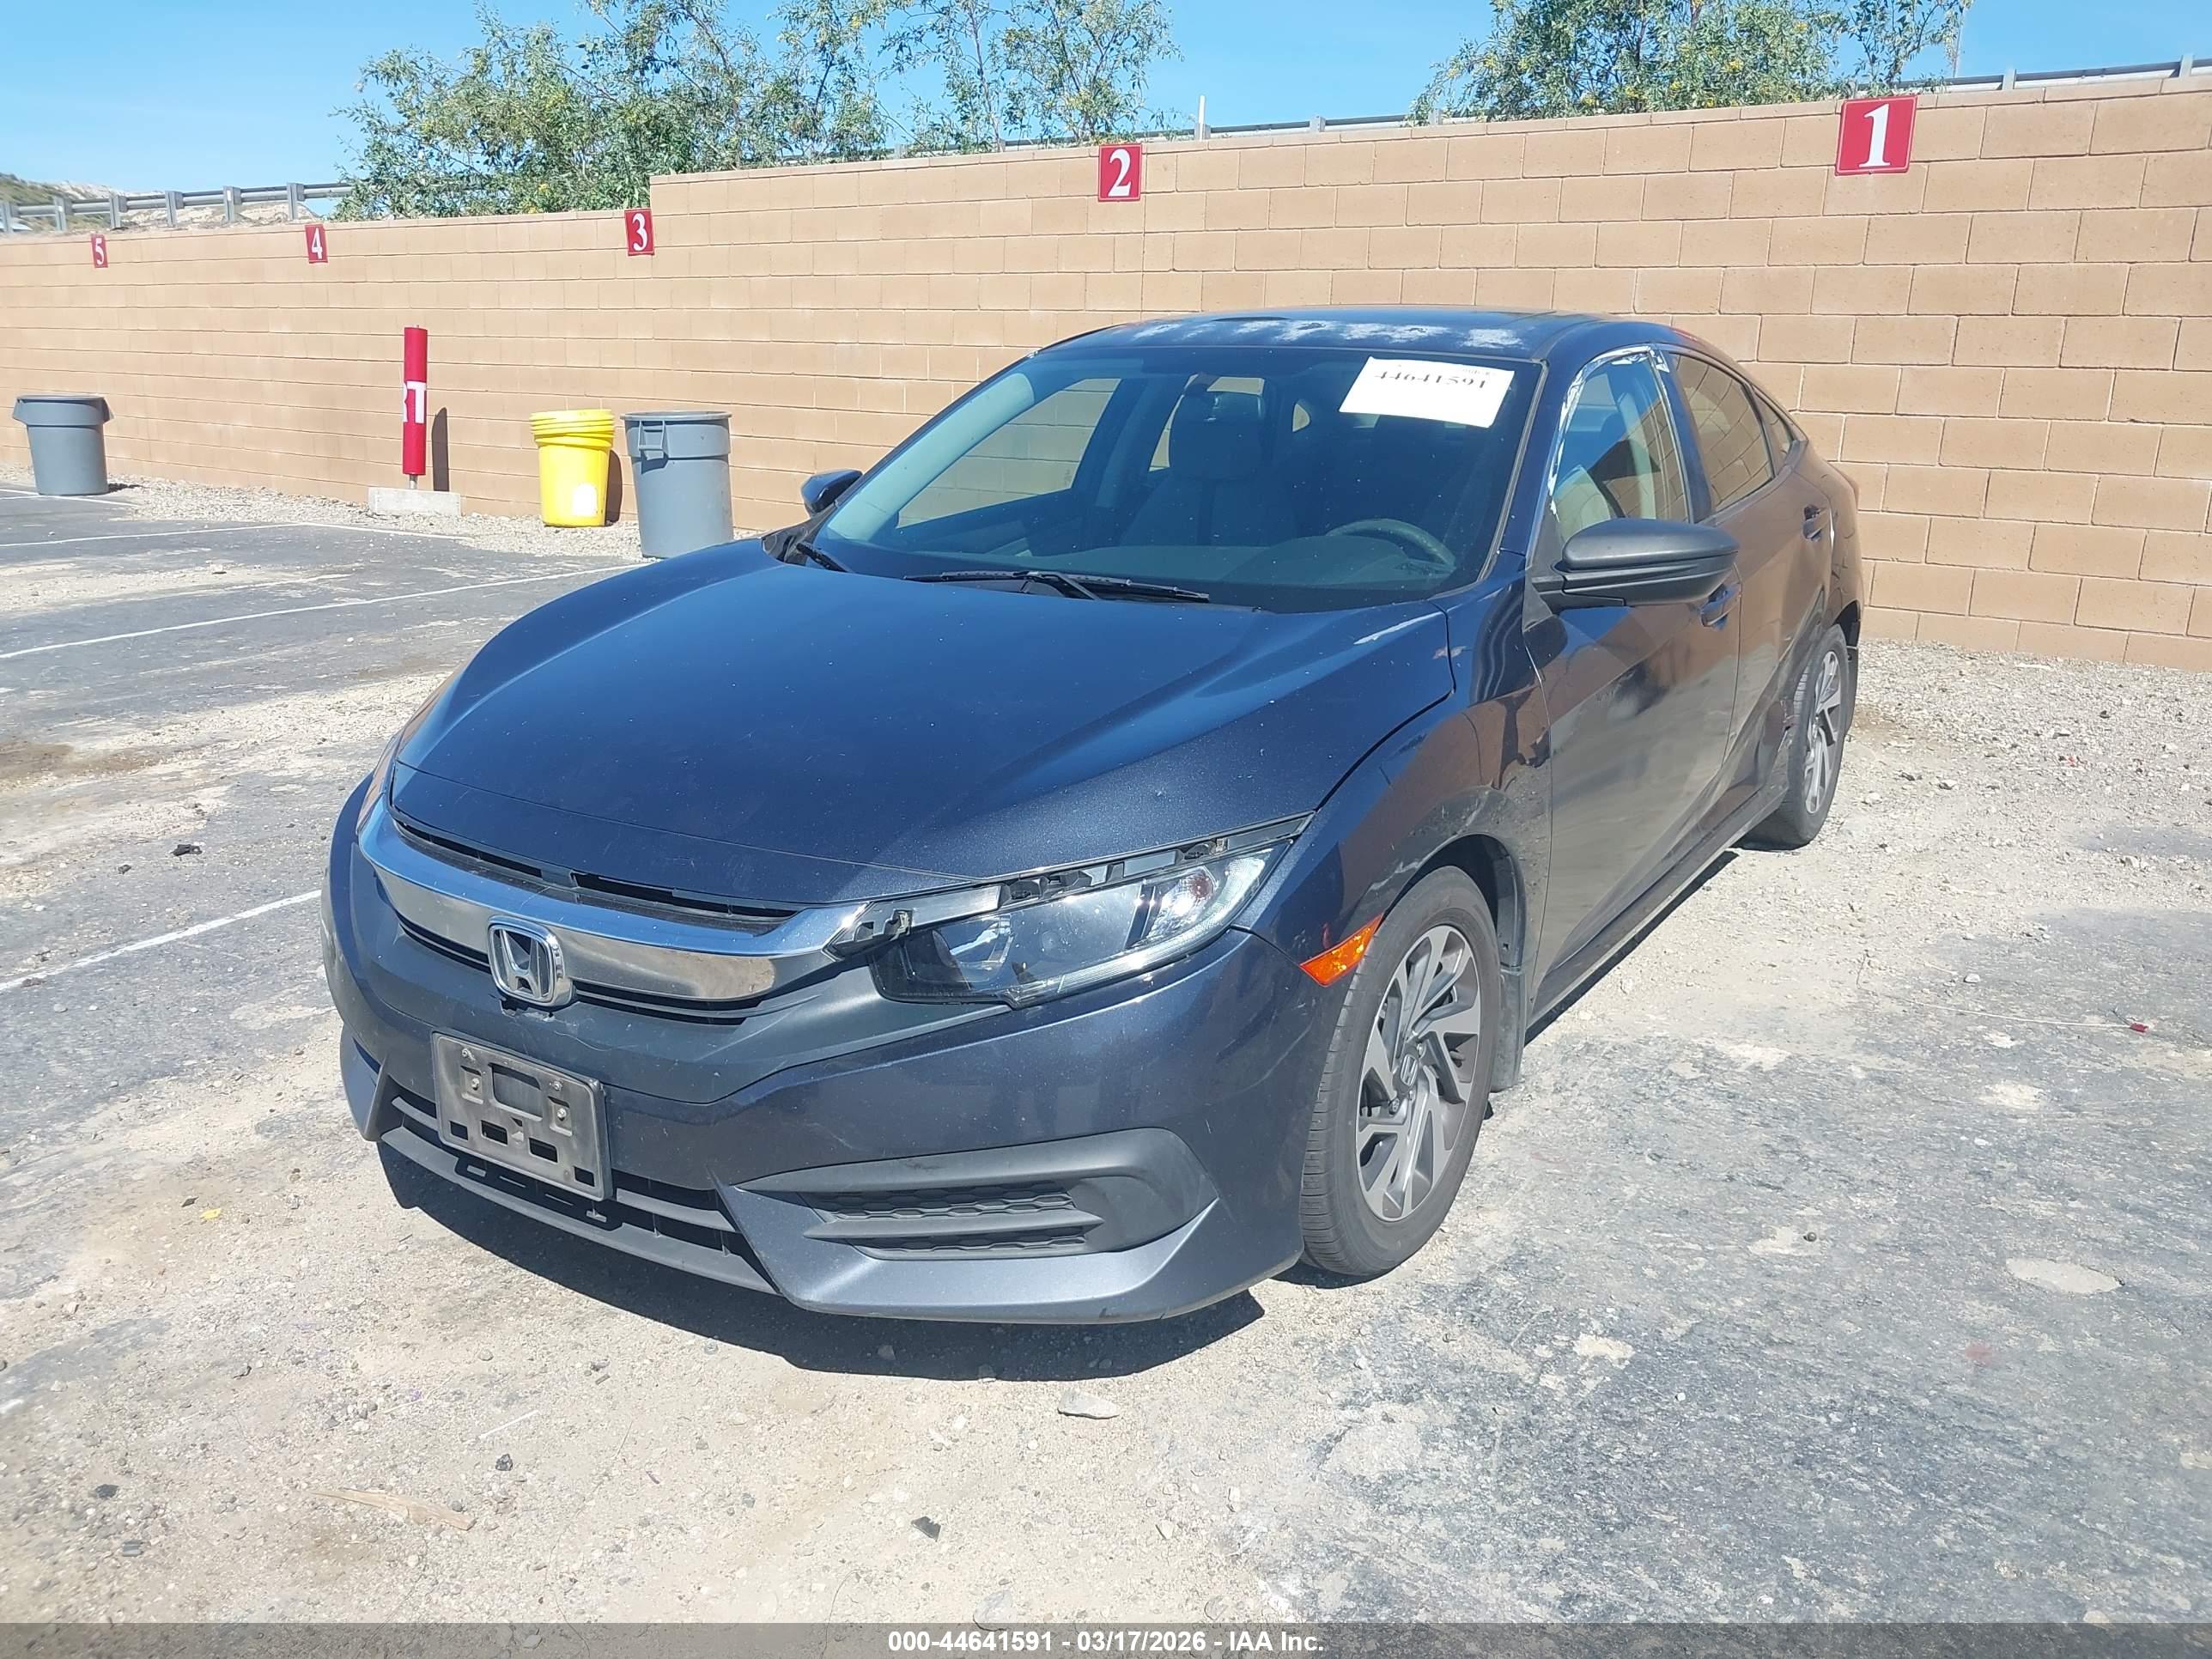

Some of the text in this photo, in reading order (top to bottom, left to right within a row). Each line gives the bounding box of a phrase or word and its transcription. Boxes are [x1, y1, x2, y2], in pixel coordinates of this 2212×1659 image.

[1858, 103, 1891, 167] 1
[1108, 148, 1132, 197] 2
[95, 237, 105, 265] 5
[311, 227, 323, 259] 4
[632, 212, 648, 252] 3
